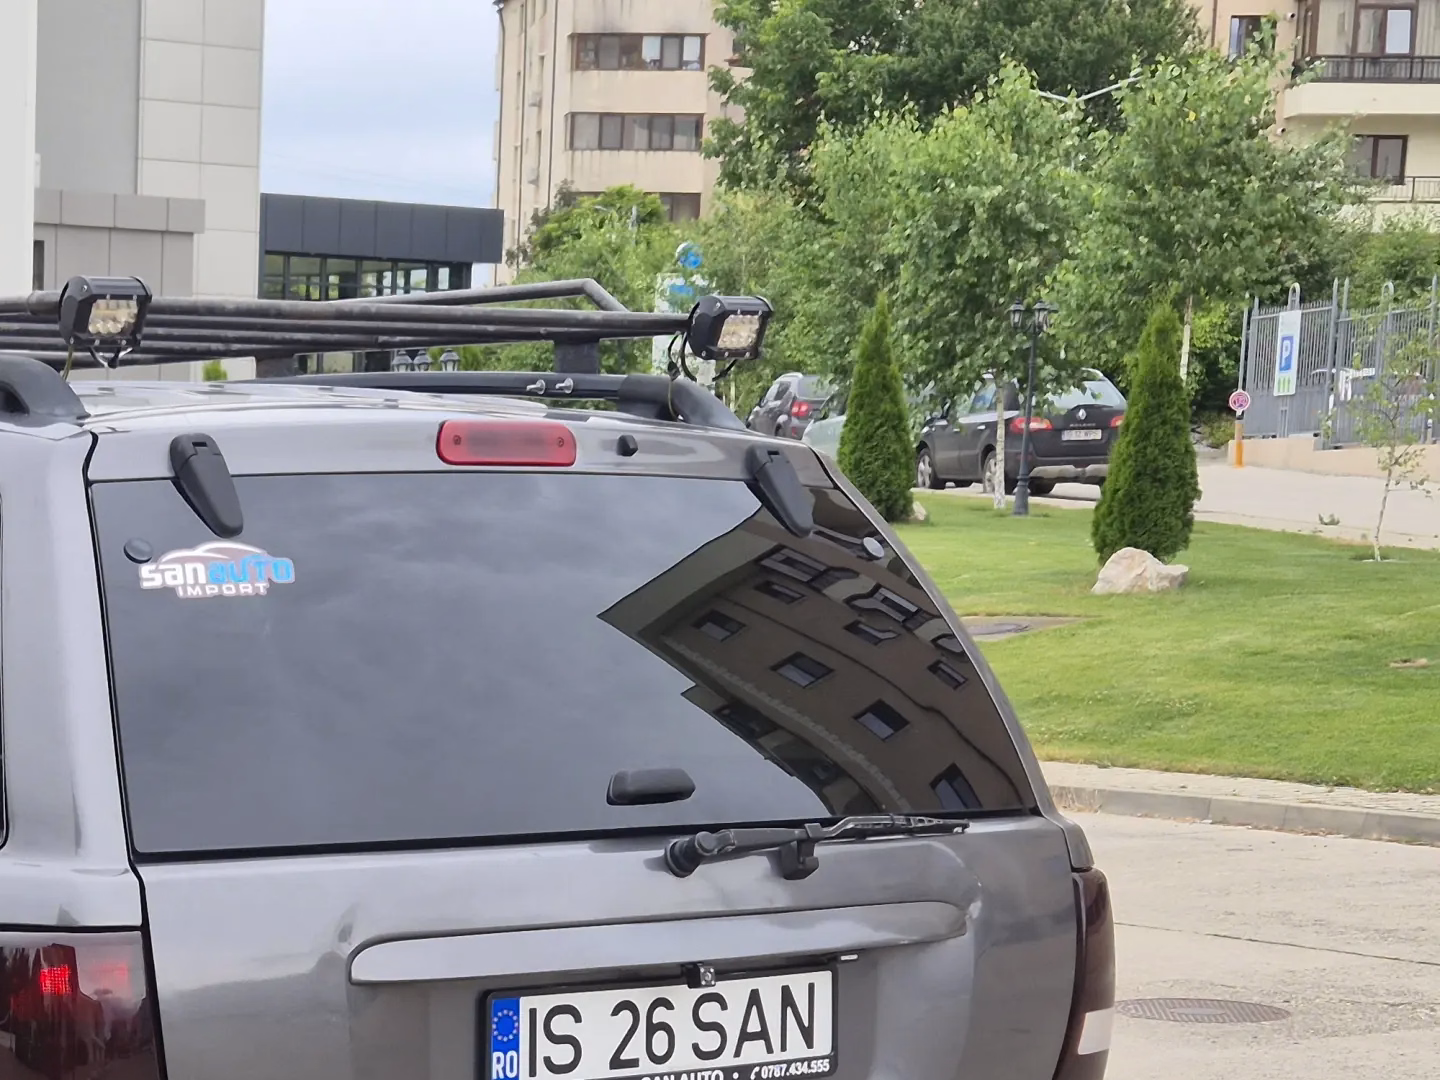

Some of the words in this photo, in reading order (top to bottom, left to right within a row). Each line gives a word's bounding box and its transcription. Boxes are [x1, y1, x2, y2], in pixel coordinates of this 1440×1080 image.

[178, 584, 268, 595] IMPORT
[528, 1003, 583, 1078] IS
[608, 997, 676, 1071] 26
[691, 982, 816, 1061] SAN
[492, 1050, 518, 1080] RO
[761, 1059, 831, 1079] 0787.434.555
